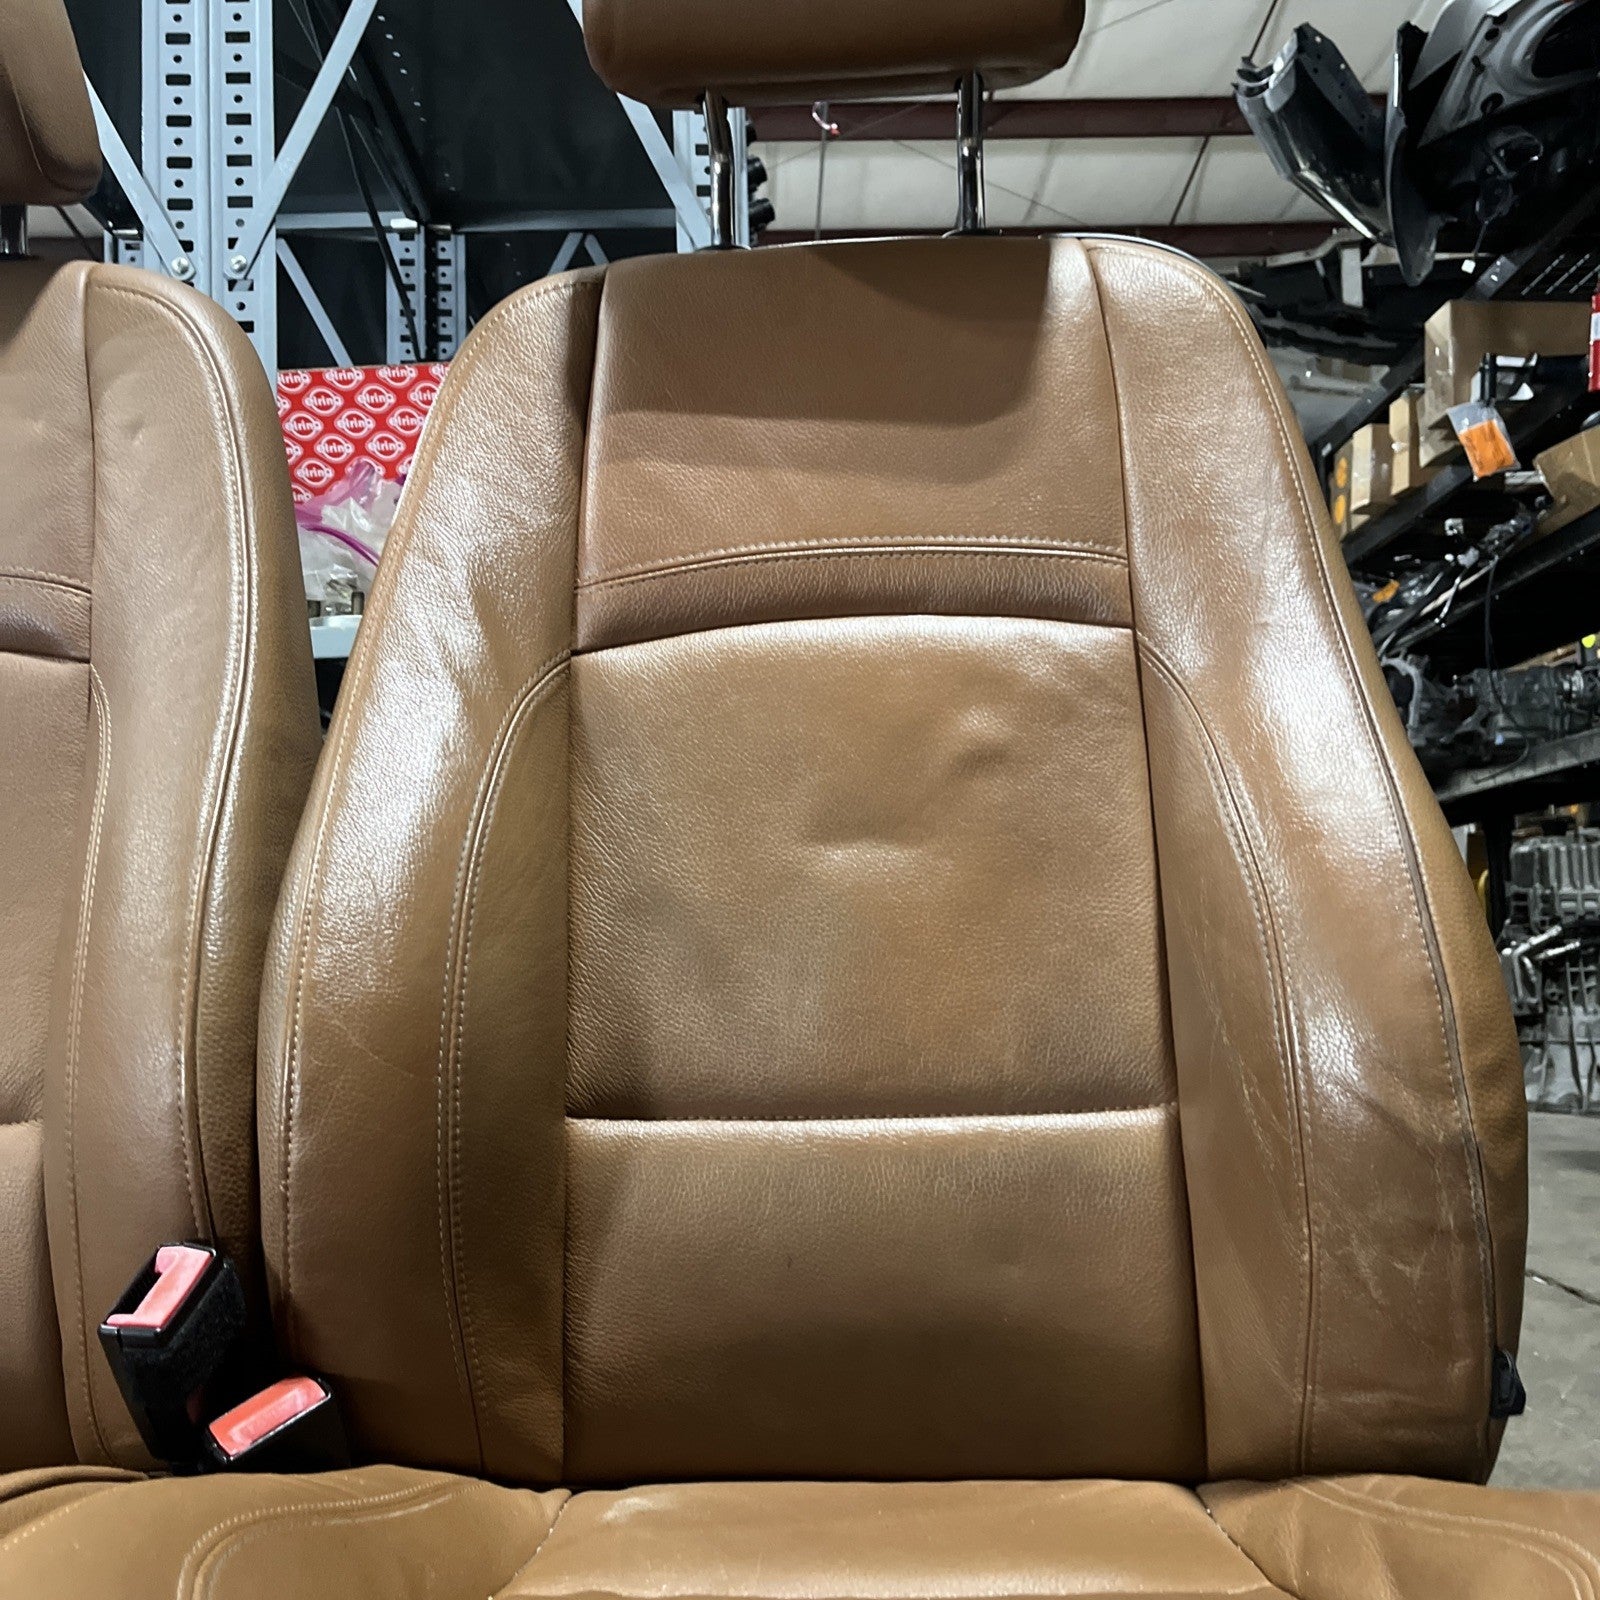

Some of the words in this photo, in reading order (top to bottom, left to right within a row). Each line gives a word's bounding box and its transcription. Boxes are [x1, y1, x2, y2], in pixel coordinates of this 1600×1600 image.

[305, 395, 342, 407] elring
[357, 392, 395, 404] elring
[410, 389, 438, 402] elrin
[285, 419, 321, 431] elring
[337, 417, 374, 428] elring
[316, 442, 353, 453] elring
[368, 440, 405, 451] elring
[297, 467, 332, 478] elring
